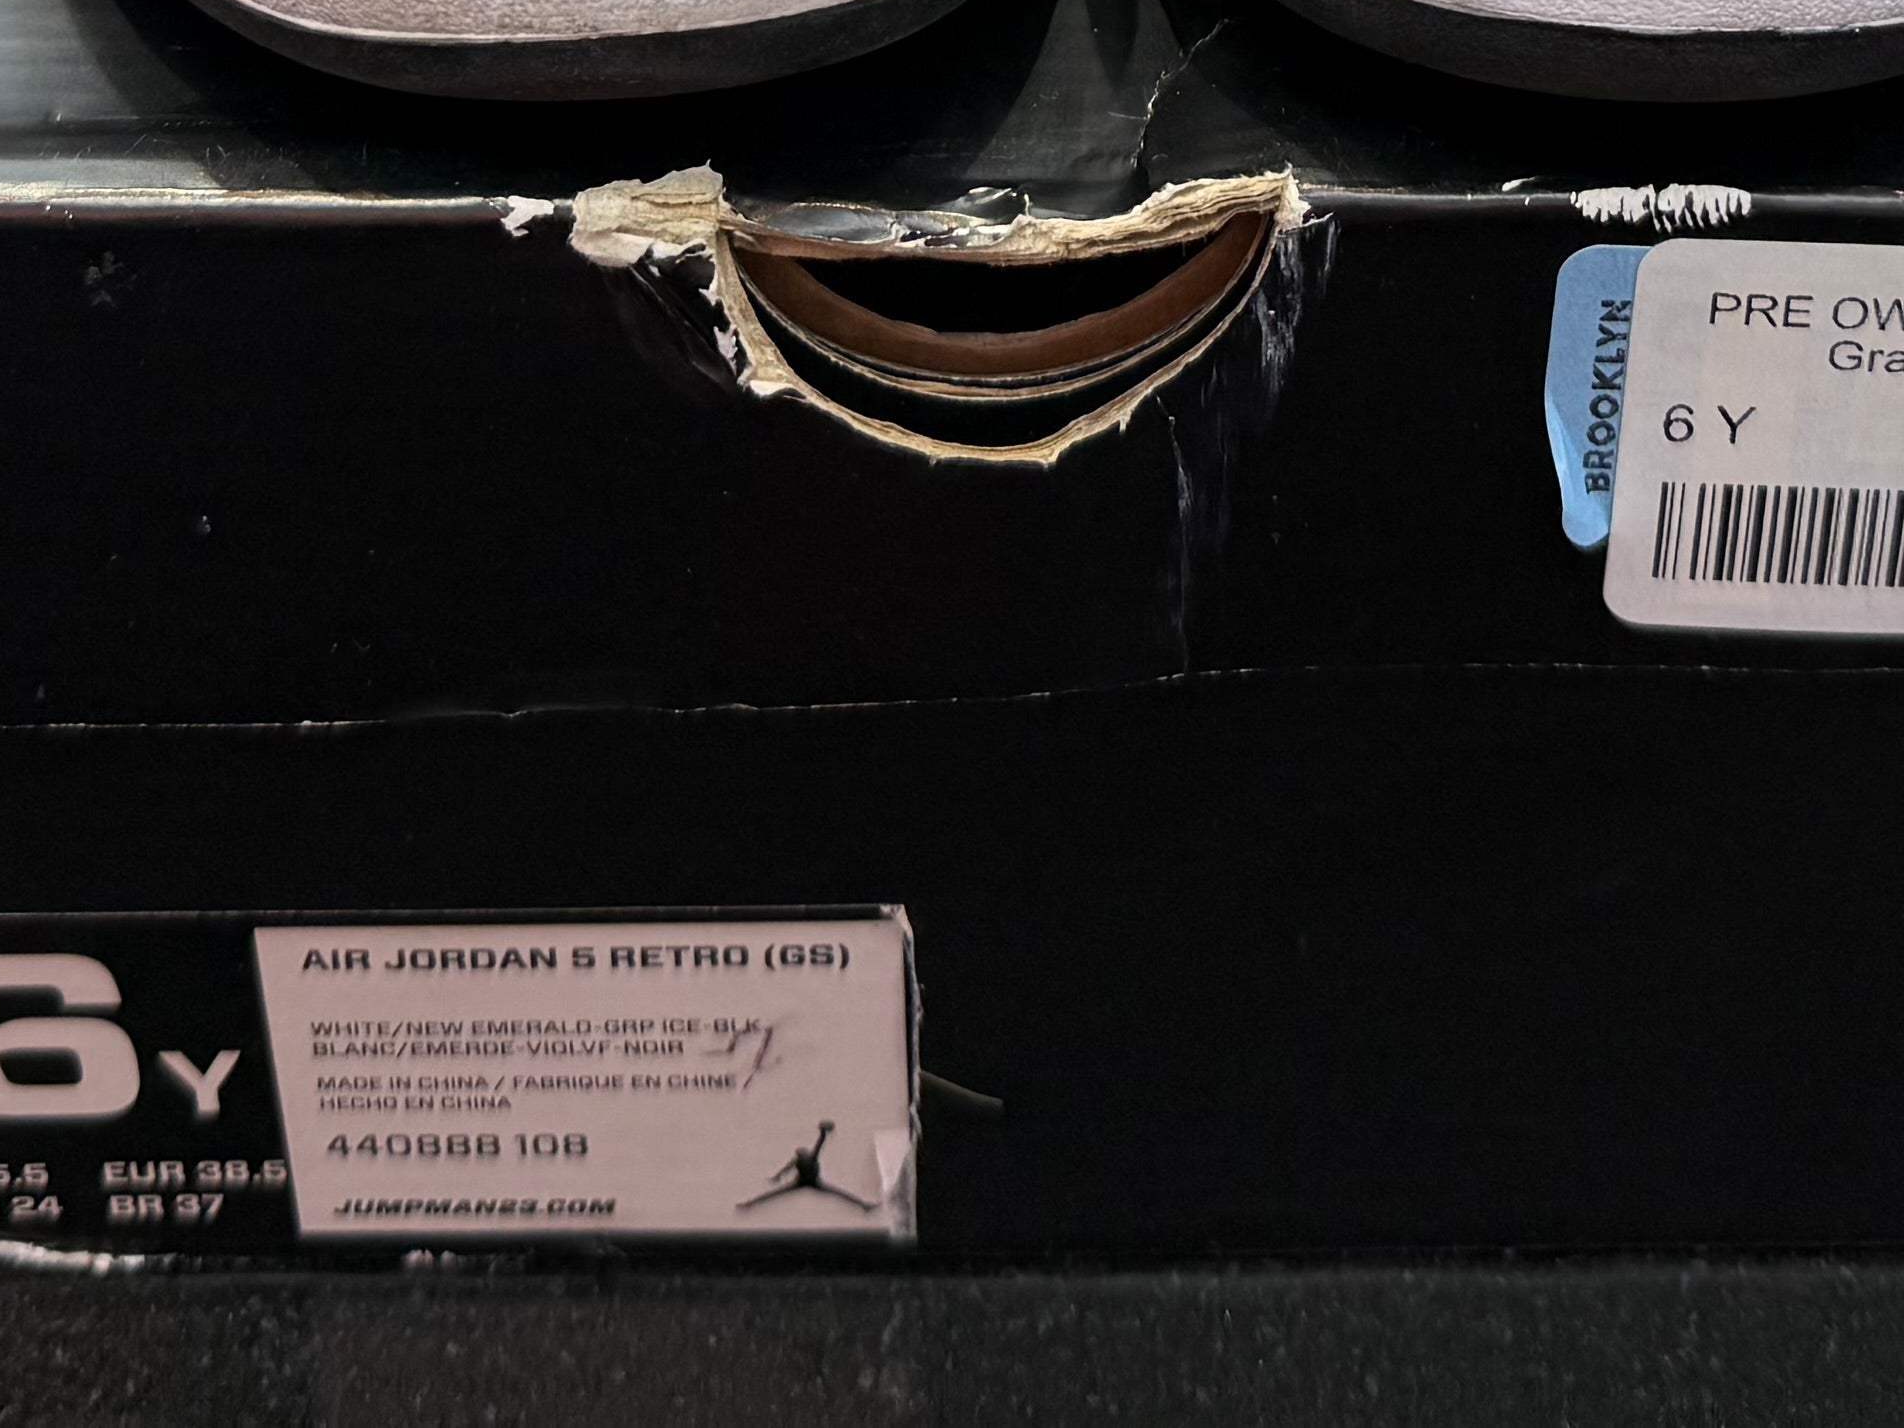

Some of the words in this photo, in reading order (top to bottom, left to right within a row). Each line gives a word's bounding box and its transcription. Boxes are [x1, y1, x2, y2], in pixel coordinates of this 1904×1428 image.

[1708, 291, 1814, 328] PRE
[1583, 299, 1632, 495] BROOKLYN
[1663, 403, 1695, 443] 6
[1716, 405, 1757, 445] Y
[302, 947, 371, 970] AIR
[385, 946, 557, 970] JORDAN
[572, 946, 596, 968] 5
[610, 945, 750, 969] RETRO
[764, 943, 851, 969] (GS)
[311, 1020, 463, 1037] WHITE/NEW
[471, 1018, 655, 1036] EMERALD-GRP
[663, 1017, 762, 1034] ICE-BLK
[157, 1049, 242, 1116] Y
[317, 1075, 383, 1091] MADE
[389, 1075, 412, 1090] IN
[418, 1074, 489, 1090] CHINA
[494, 1075, 506, 1091] /
[513, 1073, 624, 1090] FABRIQUE
[631, 1073, 662, 1089] EN
[668, 1073, 737, 1089] CHINE
[320, 1095, 397, 1111] HECHO
[404, 1095, 435, 1110] EN
[441, 1095, 513, 1110] CHINA
[326, 1133, 500, 1157] 440888
[515, 1132, 588, 1156] 108
[103, 1161, 186, 1184] EUR
[197, 1159, 287, 1183] 38.5
[11, 1195, 63, 1219] 24
[109, 1194, 163, 1217] BR
[176, 1193, 224, 1217] 37
[334, 1199, 617, 1216] JUMPMAN23.COM
